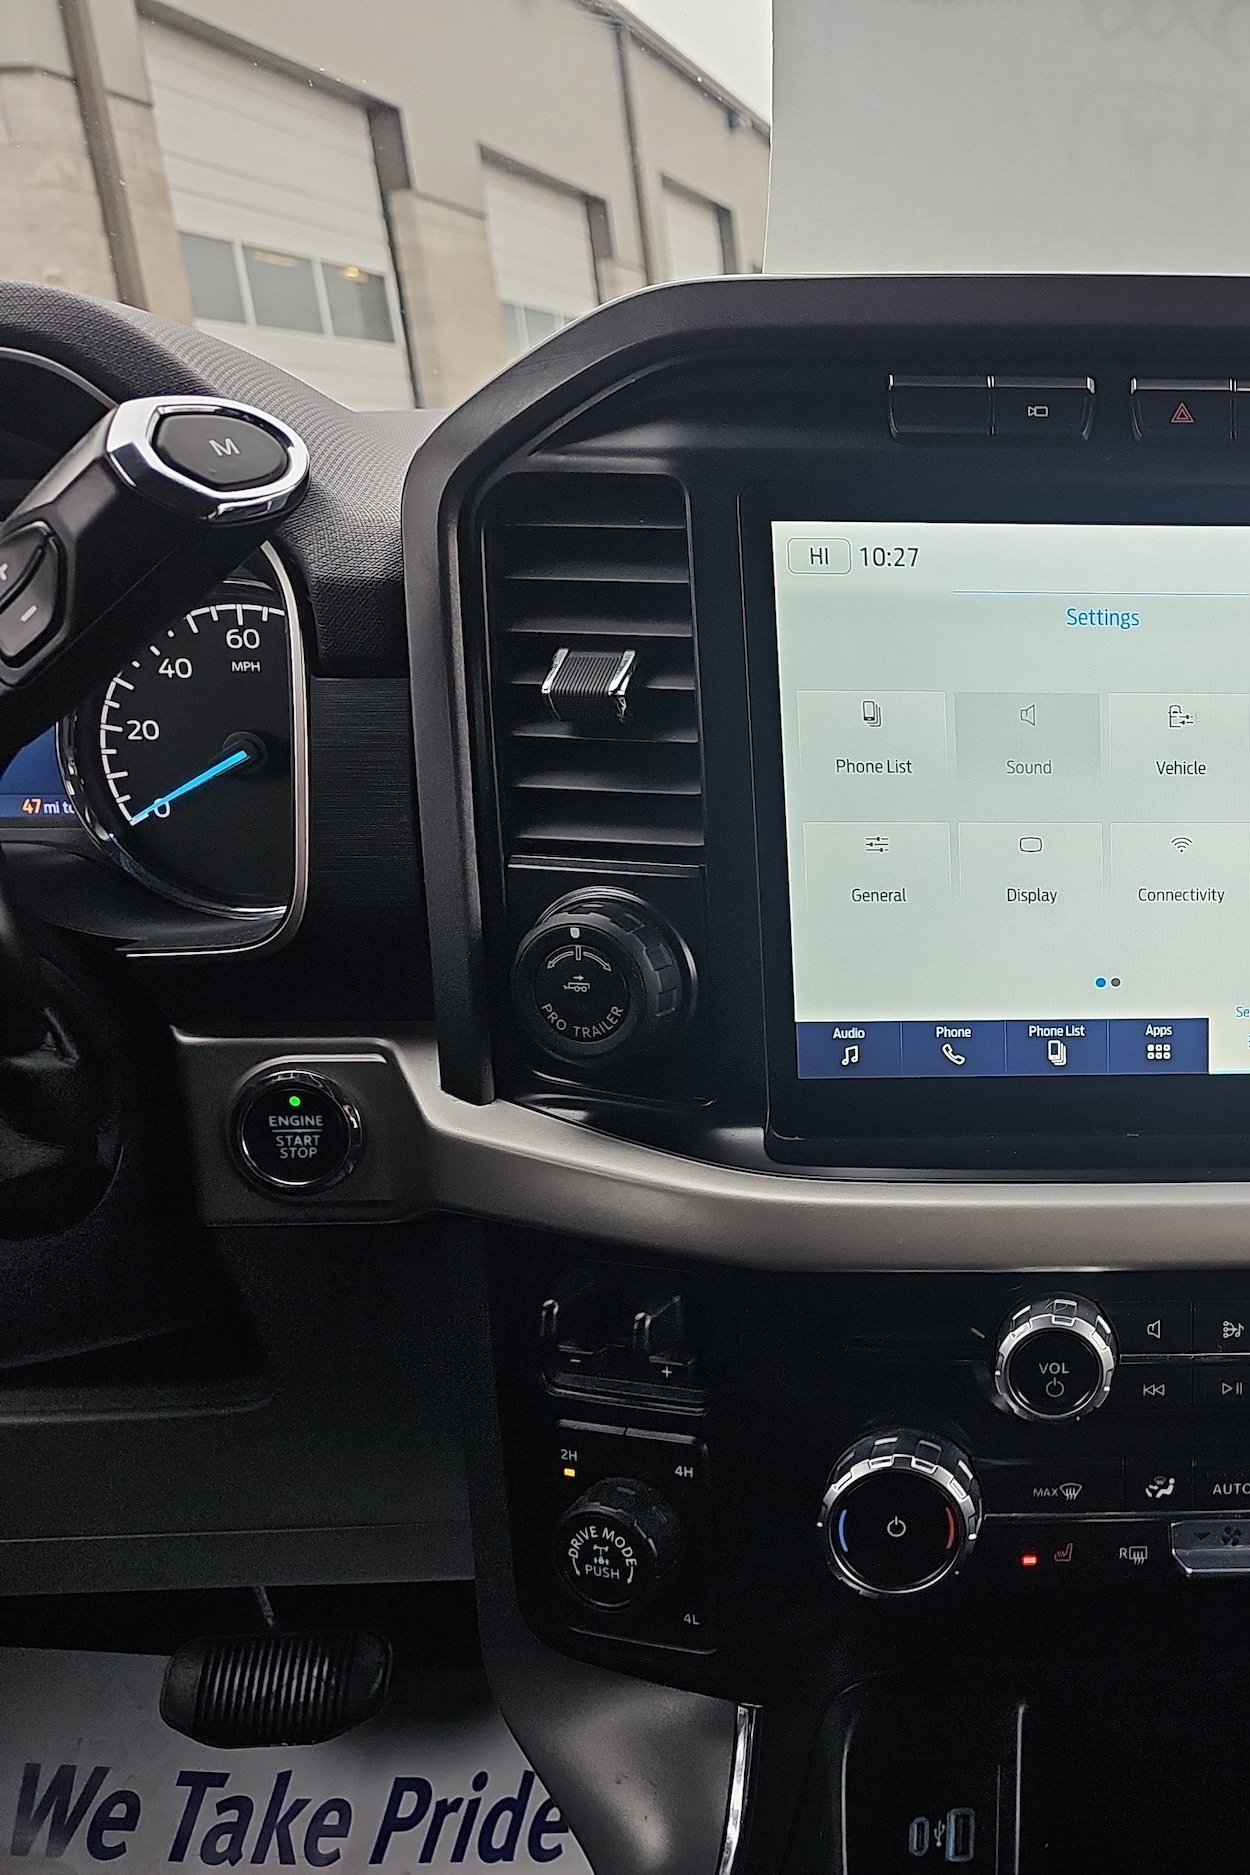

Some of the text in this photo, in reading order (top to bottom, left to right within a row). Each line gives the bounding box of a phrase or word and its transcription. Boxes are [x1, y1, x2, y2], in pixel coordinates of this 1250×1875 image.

[208, 437, 241, 458] M
[809, 547, 830, 566] HI
[858, 546, 920, 568] 10:27
[1065, 608, 1141, 630] Settings
[225, 628, 261, 650] 60
[157, 657, 194, 679] 40
[230, 660, 261, 673] MPH
[126, 719, 160, 741] 20
[835, 758, 913, 775] Phone List
[1005, 759, 1053, 776] Sound
[1155, 760, 1208, 776] Vehicle
[22, 798, 42, 815] 47
[43, 801, 60, 814] mi
[851, 887, 907, 903] General
[1006, 887, 1058, 905] Display
[1137, 887, 1226, 904] Connectivity
[541, 1003, 624, 1039] PRO TRAILER
[832, 1026, 867, 1040] Audio
[935, 1025, 973, 1039] Phone
[1028, 1024, 1086, 1038] Phone List
[1145, 1023, 1173, 1039] Apps
[268, 1115, 324, 1128] ENGINE
[275, 1134, 321, 1147] START
[279, 1147, 318, 1159] STOP
[1038, 1362, 1070, 1376] VOL
[560, 1448, 578, 1462] 2H
[674, 1465, 694, 1478] 4H
[1032, 1486, 1059, 1498] MAX
[568, 1525, 638, 1567] DRIVE MODE
[585, 1564, 620, 1580] PUSH
[683, 1613, 701, 1626] 4L
[9, 1761, 570, 1868] We Take Pride
